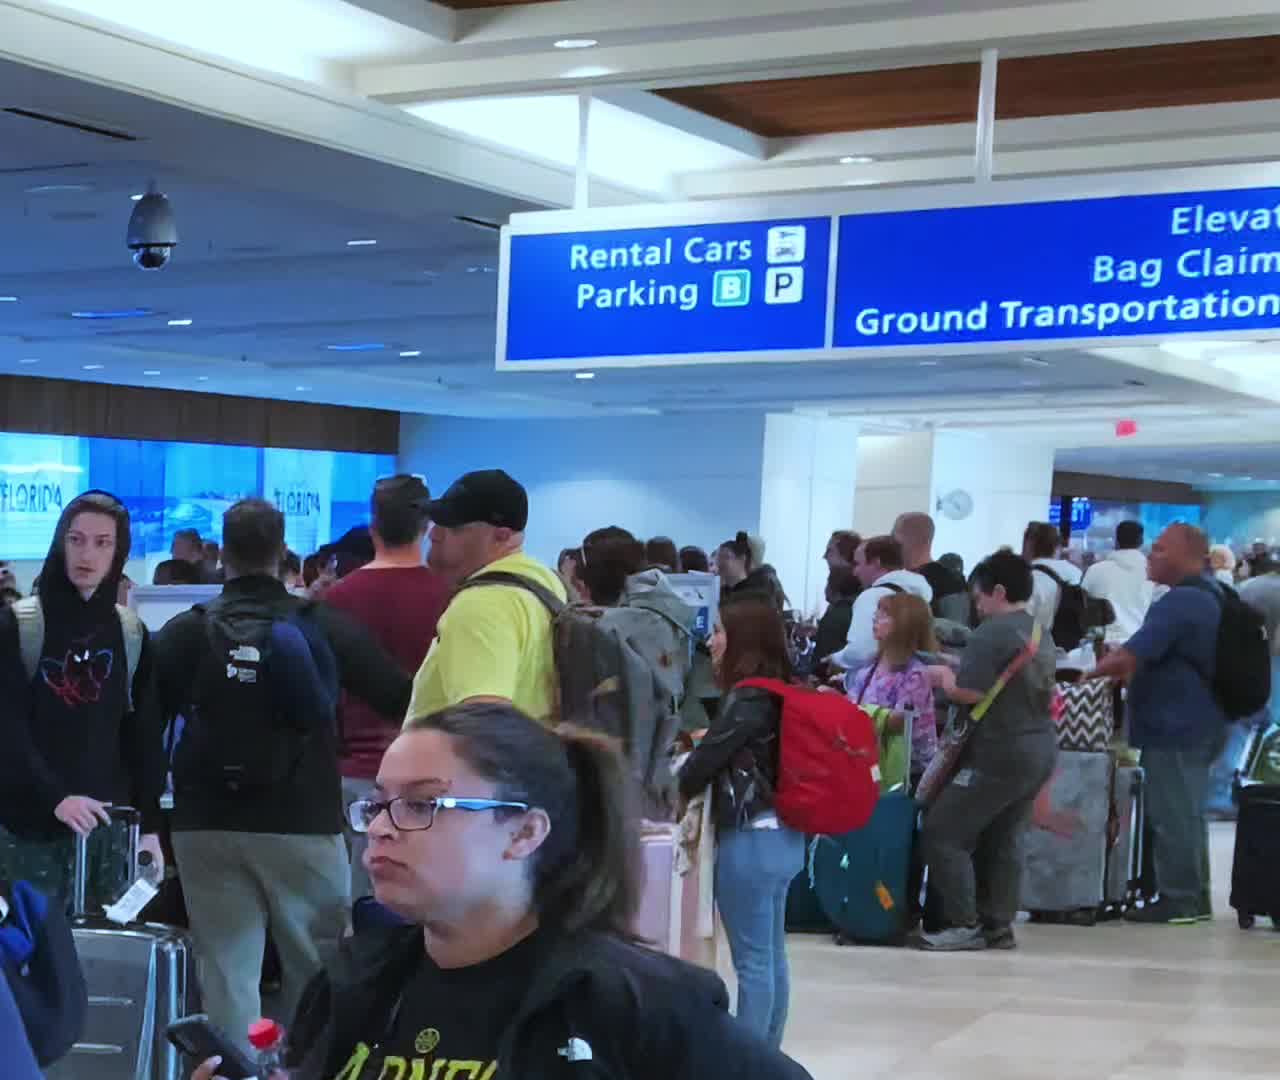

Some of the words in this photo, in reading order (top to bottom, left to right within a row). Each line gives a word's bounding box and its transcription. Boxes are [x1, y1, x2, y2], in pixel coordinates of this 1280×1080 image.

[570, 238, 672, 270] Rental
[684, 237, 752, 264] Cars
[1093, 255, 1162, 287] Bag
[1177, 247, 1280, 278] Claim
[577, 279, 699, 311] Parking
[721, 275, 742, 300] B
[774, 273, 794, 297] P
[855, 302, 988, 335] Ground
[999, 289, 1280, 330] Transportation
